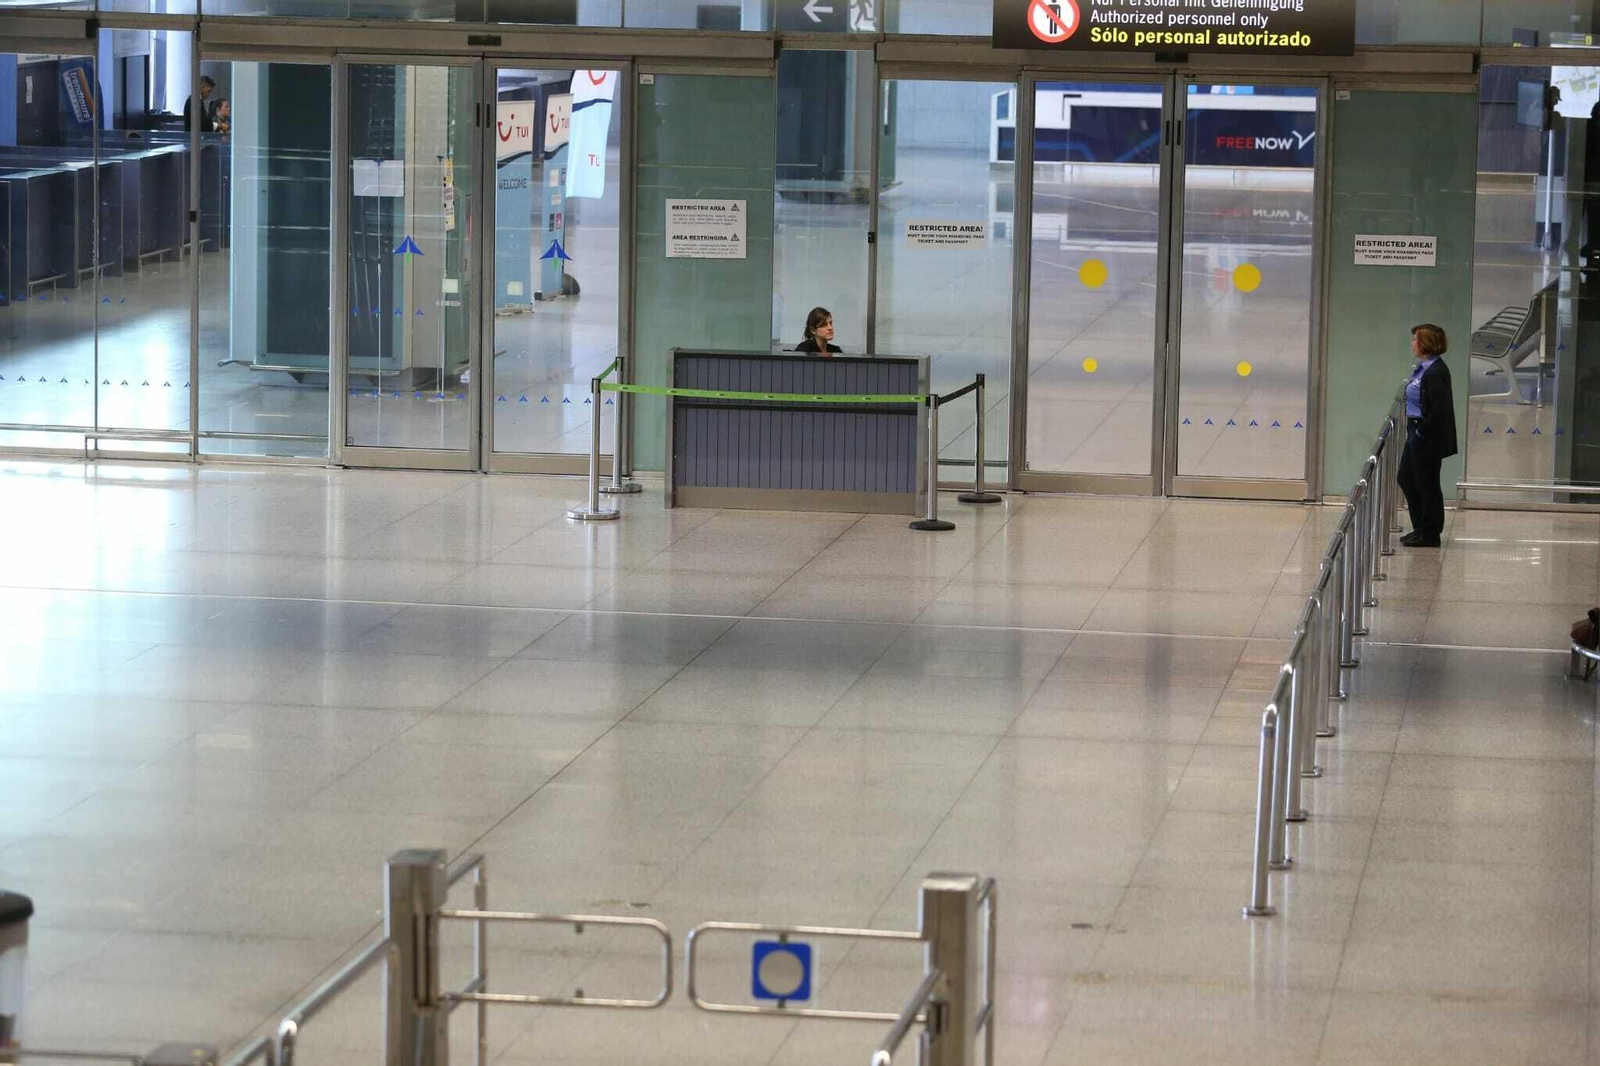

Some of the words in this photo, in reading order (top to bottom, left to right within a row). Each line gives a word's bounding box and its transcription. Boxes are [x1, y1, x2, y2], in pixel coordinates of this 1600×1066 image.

[1090, 10, 1163, 24] Authorized
[1168, 12, 1236, 27] personnel
[1240, 13, 1269, 29] only
[1090, 26, 1129, 43] Sólo
[1134, 29, 1210, 46] personal
[1216, 30, 1312, 47] autorizado
[516, 126, 529, 138] TUI
[498, 178, 528, 190] WELCOME
